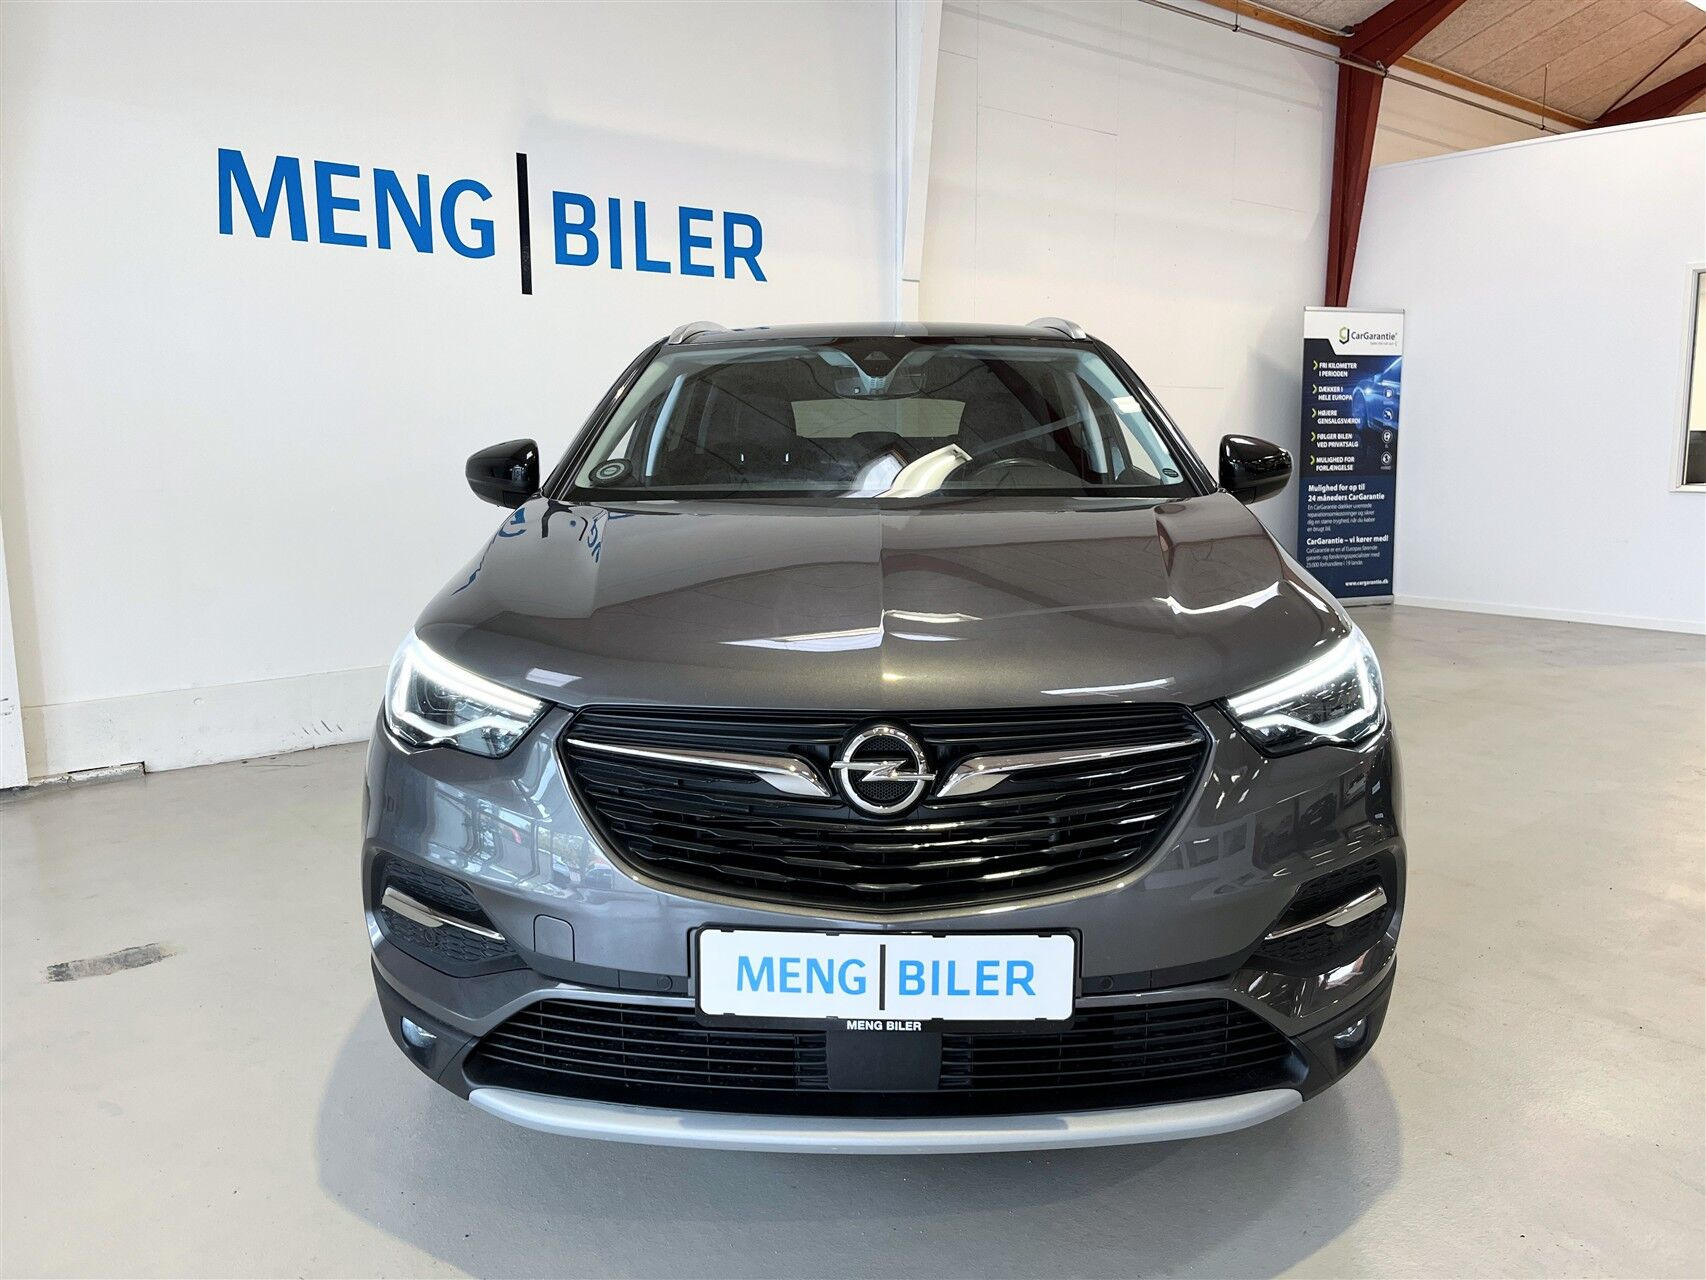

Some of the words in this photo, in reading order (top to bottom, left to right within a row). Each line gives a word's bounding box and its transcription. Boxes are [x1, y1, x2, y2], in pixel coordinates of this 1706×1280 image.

[218, 147, 495, 259] MENG
[552, 190, 768, 282] BILER
[1308, 484, 1338, 493] Mulighed
[1306, 537, 1343, 545] CarGarantie
[736, 955, 866, 995] MENG
[898, 960, 1036, 996] BILER
[846, 1020, 883, 1030] MENG
[886, 1021, 922, 1031] BILER
